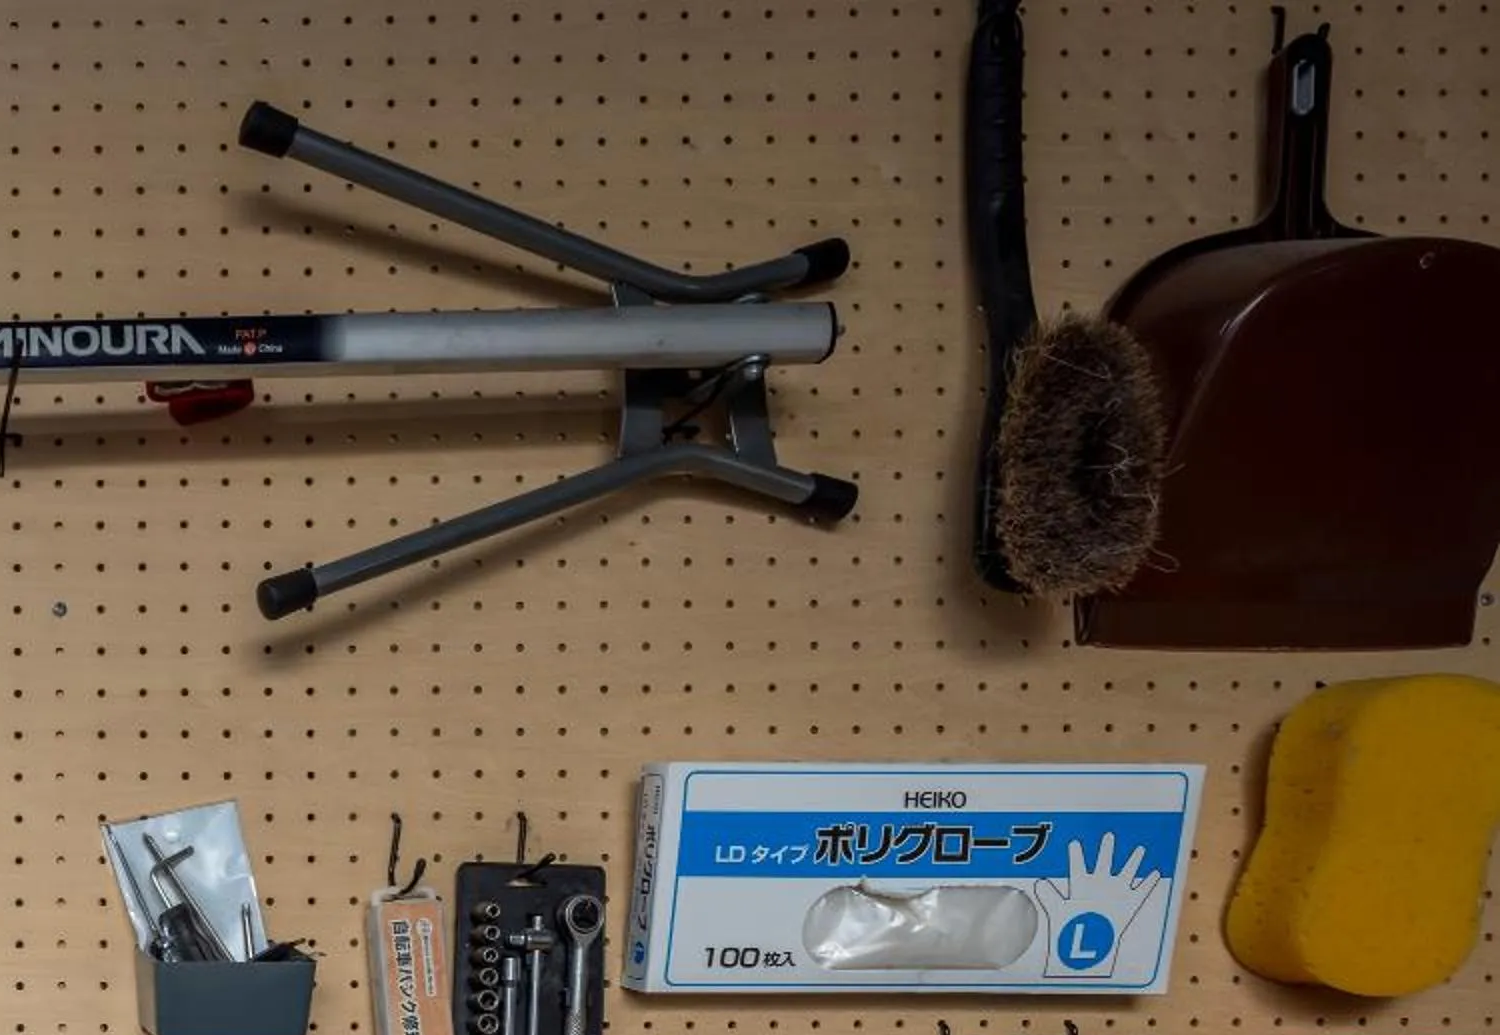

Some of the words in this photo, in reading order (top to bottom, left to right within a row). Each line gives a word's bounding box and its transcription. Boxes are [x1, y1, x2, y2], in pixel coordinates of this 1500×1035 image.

[903, 790, 968, 810] HEIKO
[715, 845, 745, 863] LD
[750, 843, 811, 864] タイプ
[812, 821, 1053, 867] ポリグローブ
[1069, 922, 1097, 960] L
